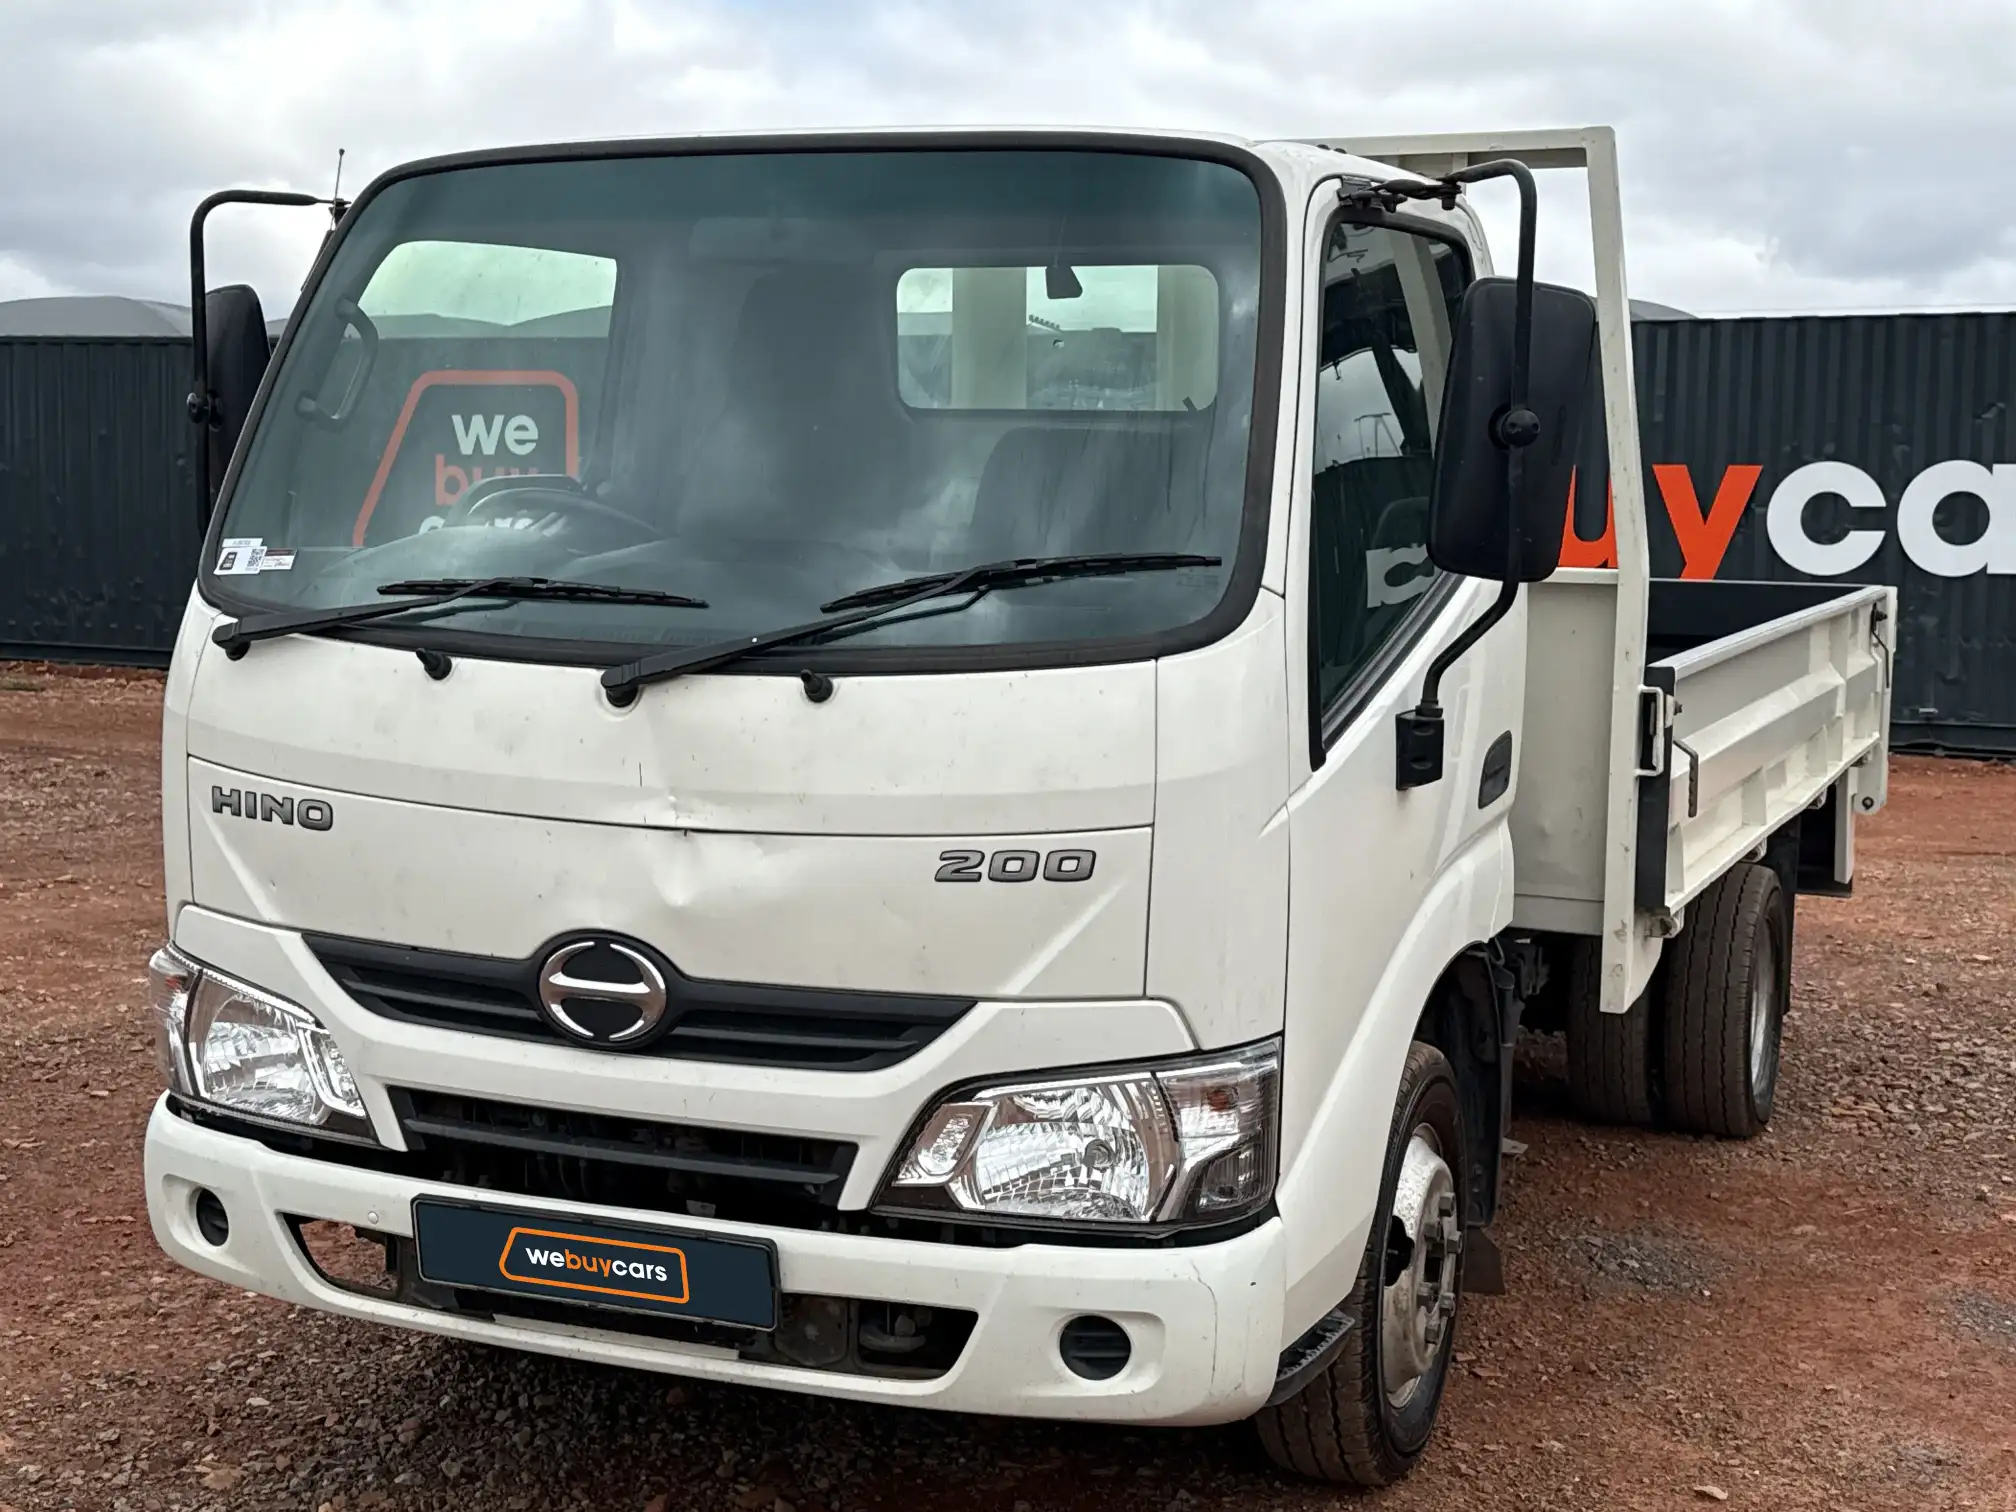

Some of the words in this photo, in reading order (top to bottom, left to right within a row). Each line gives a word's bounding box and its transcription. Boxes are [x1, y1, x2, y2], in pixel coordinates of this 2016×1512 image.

[452, 414, 539, 456] we
[211, 785, 333, 831] HINO
[934, 849, 1097, 883] 200
[525, 1247, 668, 1282] webuycars
